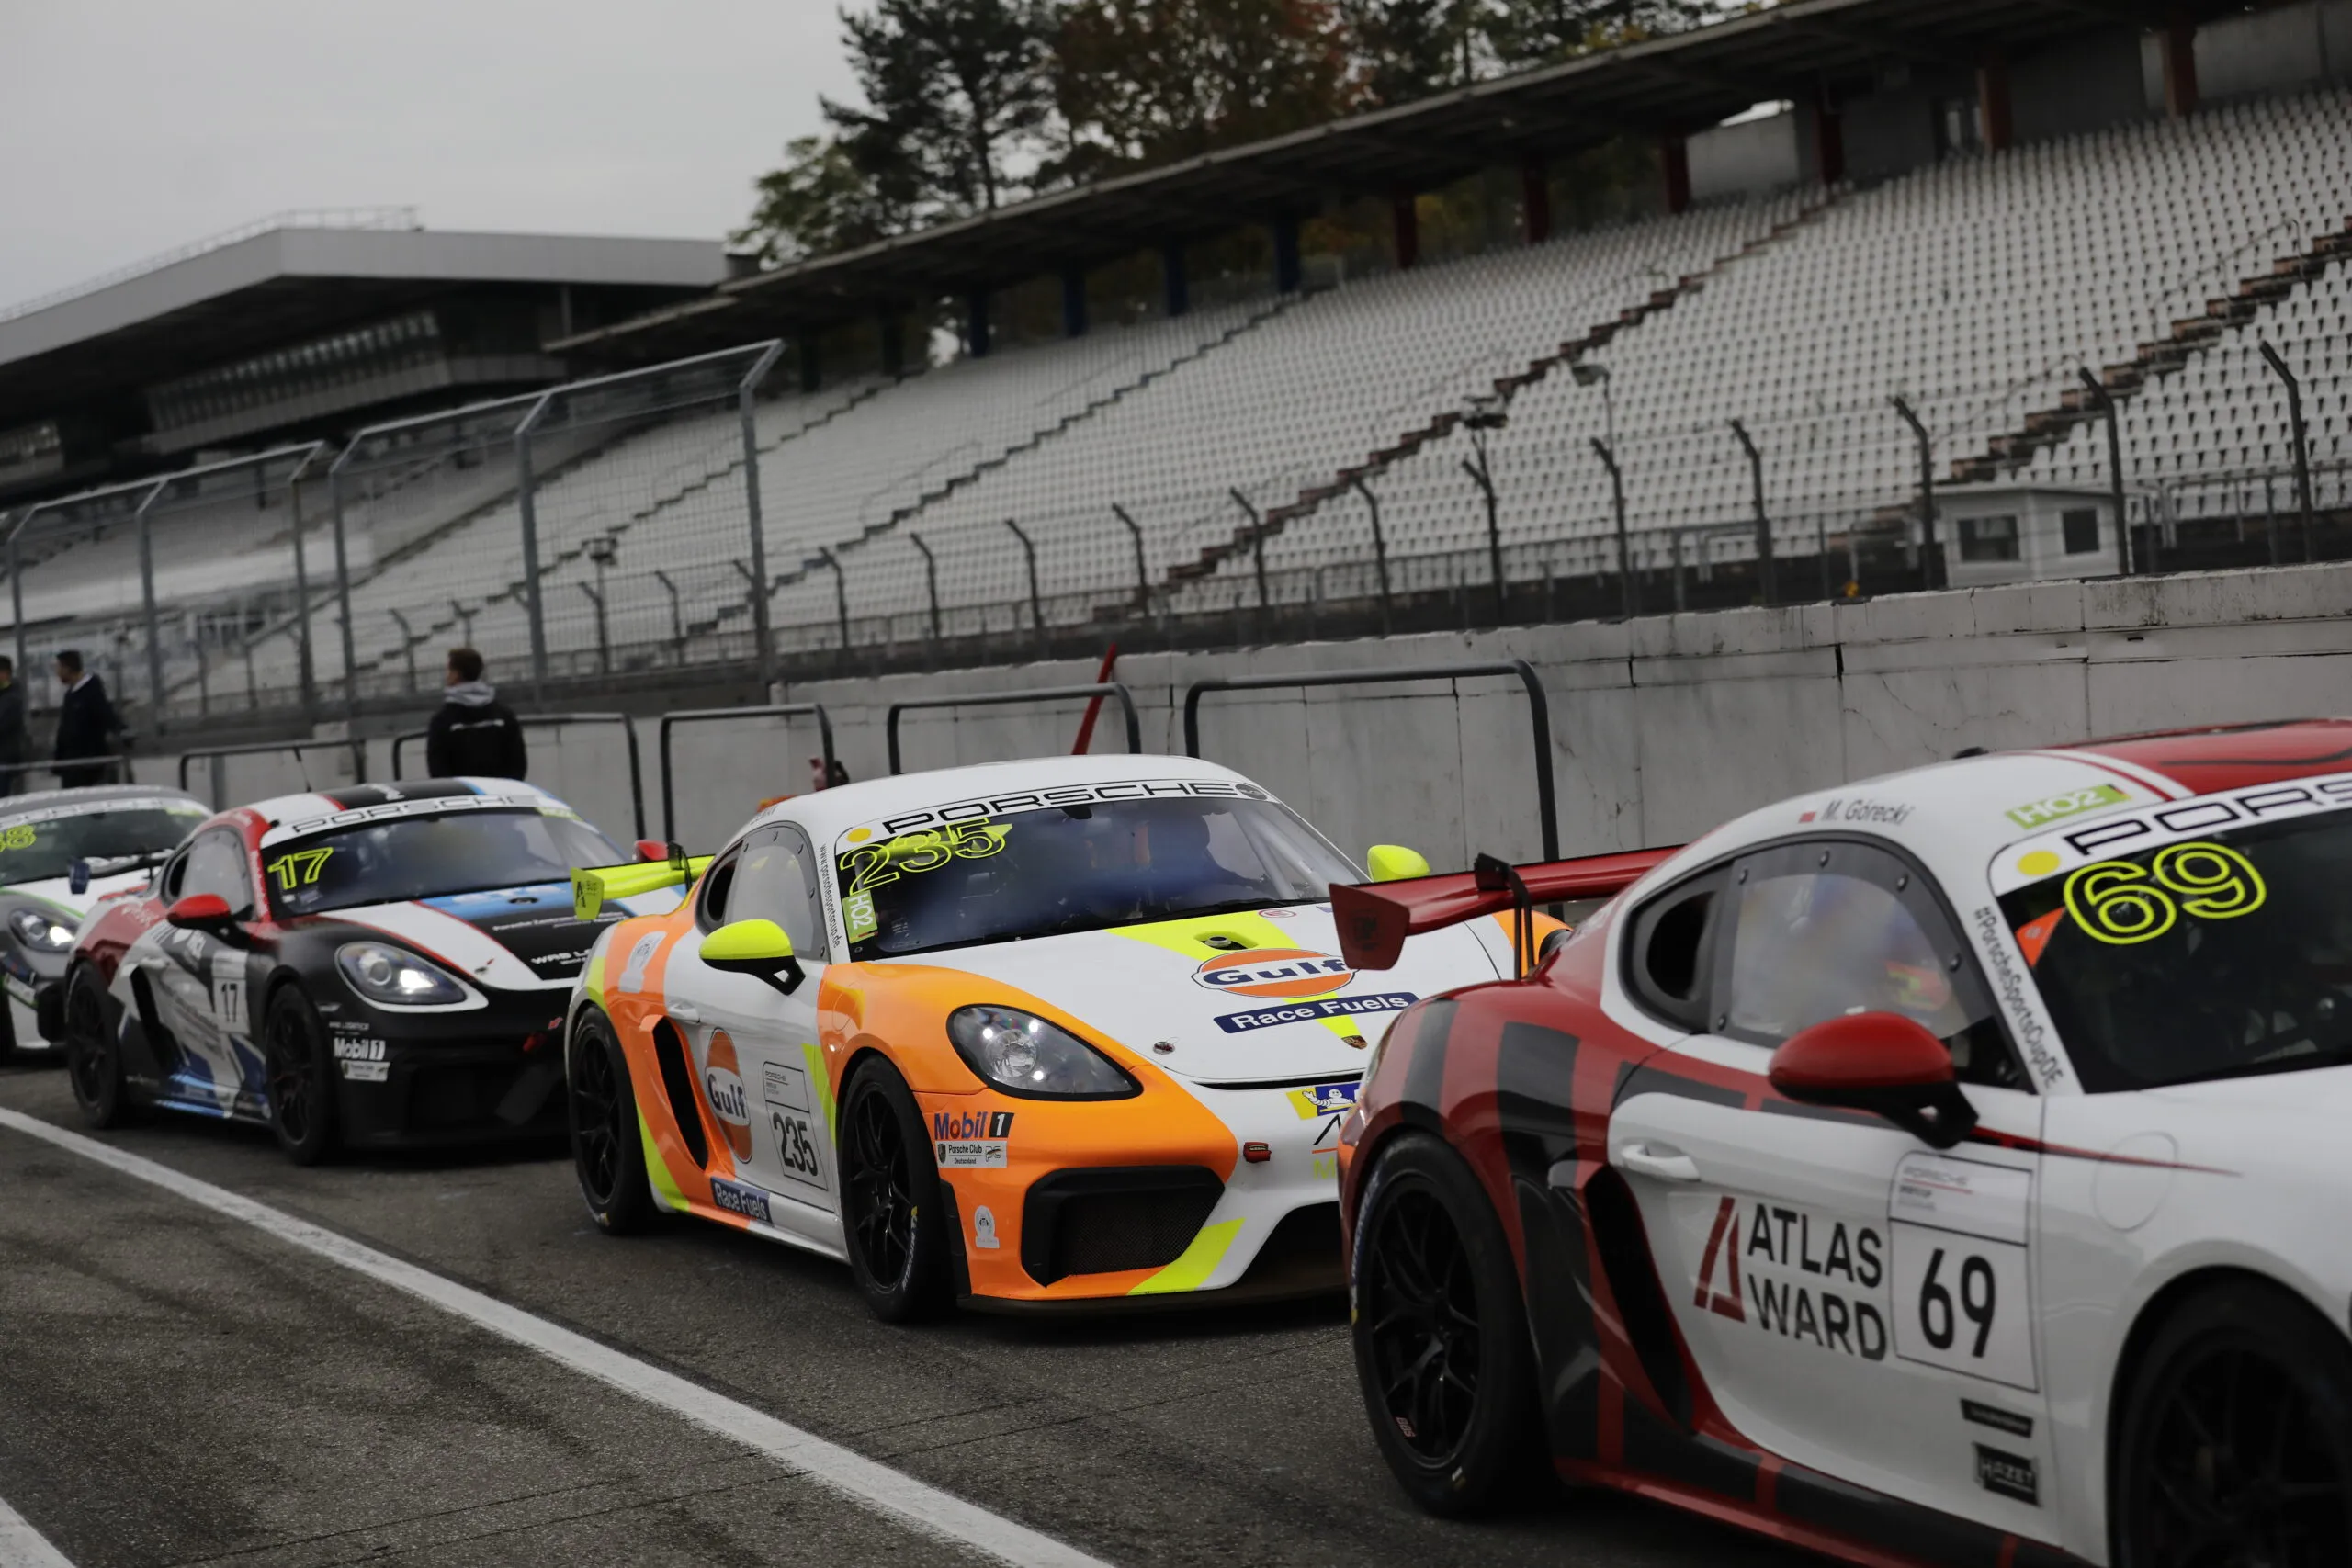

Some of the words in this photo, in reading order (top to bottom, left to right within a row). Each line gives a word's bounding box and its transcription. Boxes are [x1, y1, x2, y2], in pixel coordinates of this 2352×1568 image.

[881, 783, 1235, 835] PORSCHE
[2013, 789, 2106, 824] HO2
[267, 846, 334, 890] 17
[840, 817, 1006, 897] 235
[849, 892, 874, 931] HO2
[2063, 841, 2267, 945] 69
[1203, 958, 1348, 986] Gulf
[220, 982, 238, 1023] 17
[1231, 1002, 1316, 1030] Race
[1318, 995, 1410, 1017] Fuels
[334, 1037, 369, 1060] Mobil
[707, 1073, 747, 1120] Gulf
[772, 1111, 818, 1177] 235
[933, 1111, 989, 1140] Mobil
[948, 1144, 968, 1154] Porsche
[969, 1144, 983, 1154] Club
[714, 1181, 741, 1213] Race
[741, 1191, 768, 1223] Fuels
[1747, 1202, 1883, 1289] ATLAS
[1747, 1272, 1888, 1362] WARD
[1918, 1247, 1996, 1359] 69
